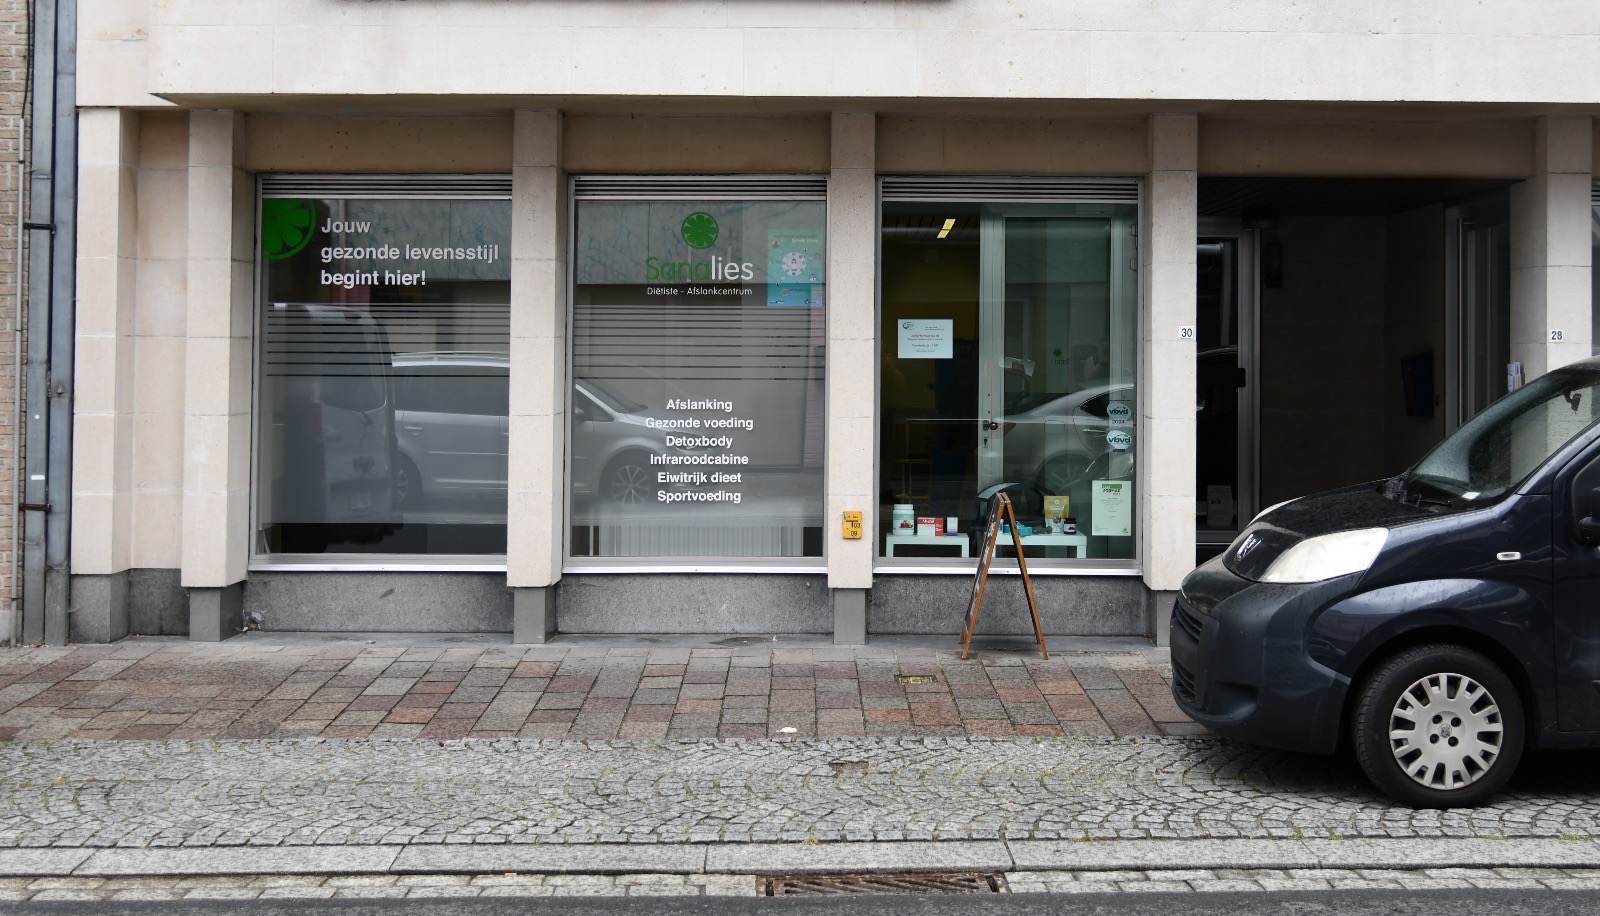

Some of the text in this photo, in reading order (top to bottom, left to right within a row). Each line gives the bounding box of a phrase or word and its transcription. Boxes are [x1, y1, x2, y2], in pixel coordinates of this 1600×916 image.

[321, 217, 371, 234] Jouw
[320, 244, 499, 263] gezonde levensstijl
[645, 255, 754, 281] Sanalies
[320, 270, 426, 289] begint hier!
[646, 286, 679, 296] Diëtiste
[686, 286, 753, 296] Afslankcentrum
[1181, 327, 1193, 338] 30
[1551, 330, 1563, 341] 28
[666, 399, 733, 412] Afslanking
[1109, 407, 1129, 415] vbvd
[645, 417, 754, 430] Gezonde voeding
[666, 435, 733, 448] Detoxbody
[650, 454, 749, 465] Infraroodcabine
[657, 472, 742, 485] Eiwitrijk dieet
[657, 490, 742, 503] Sportvoeding
